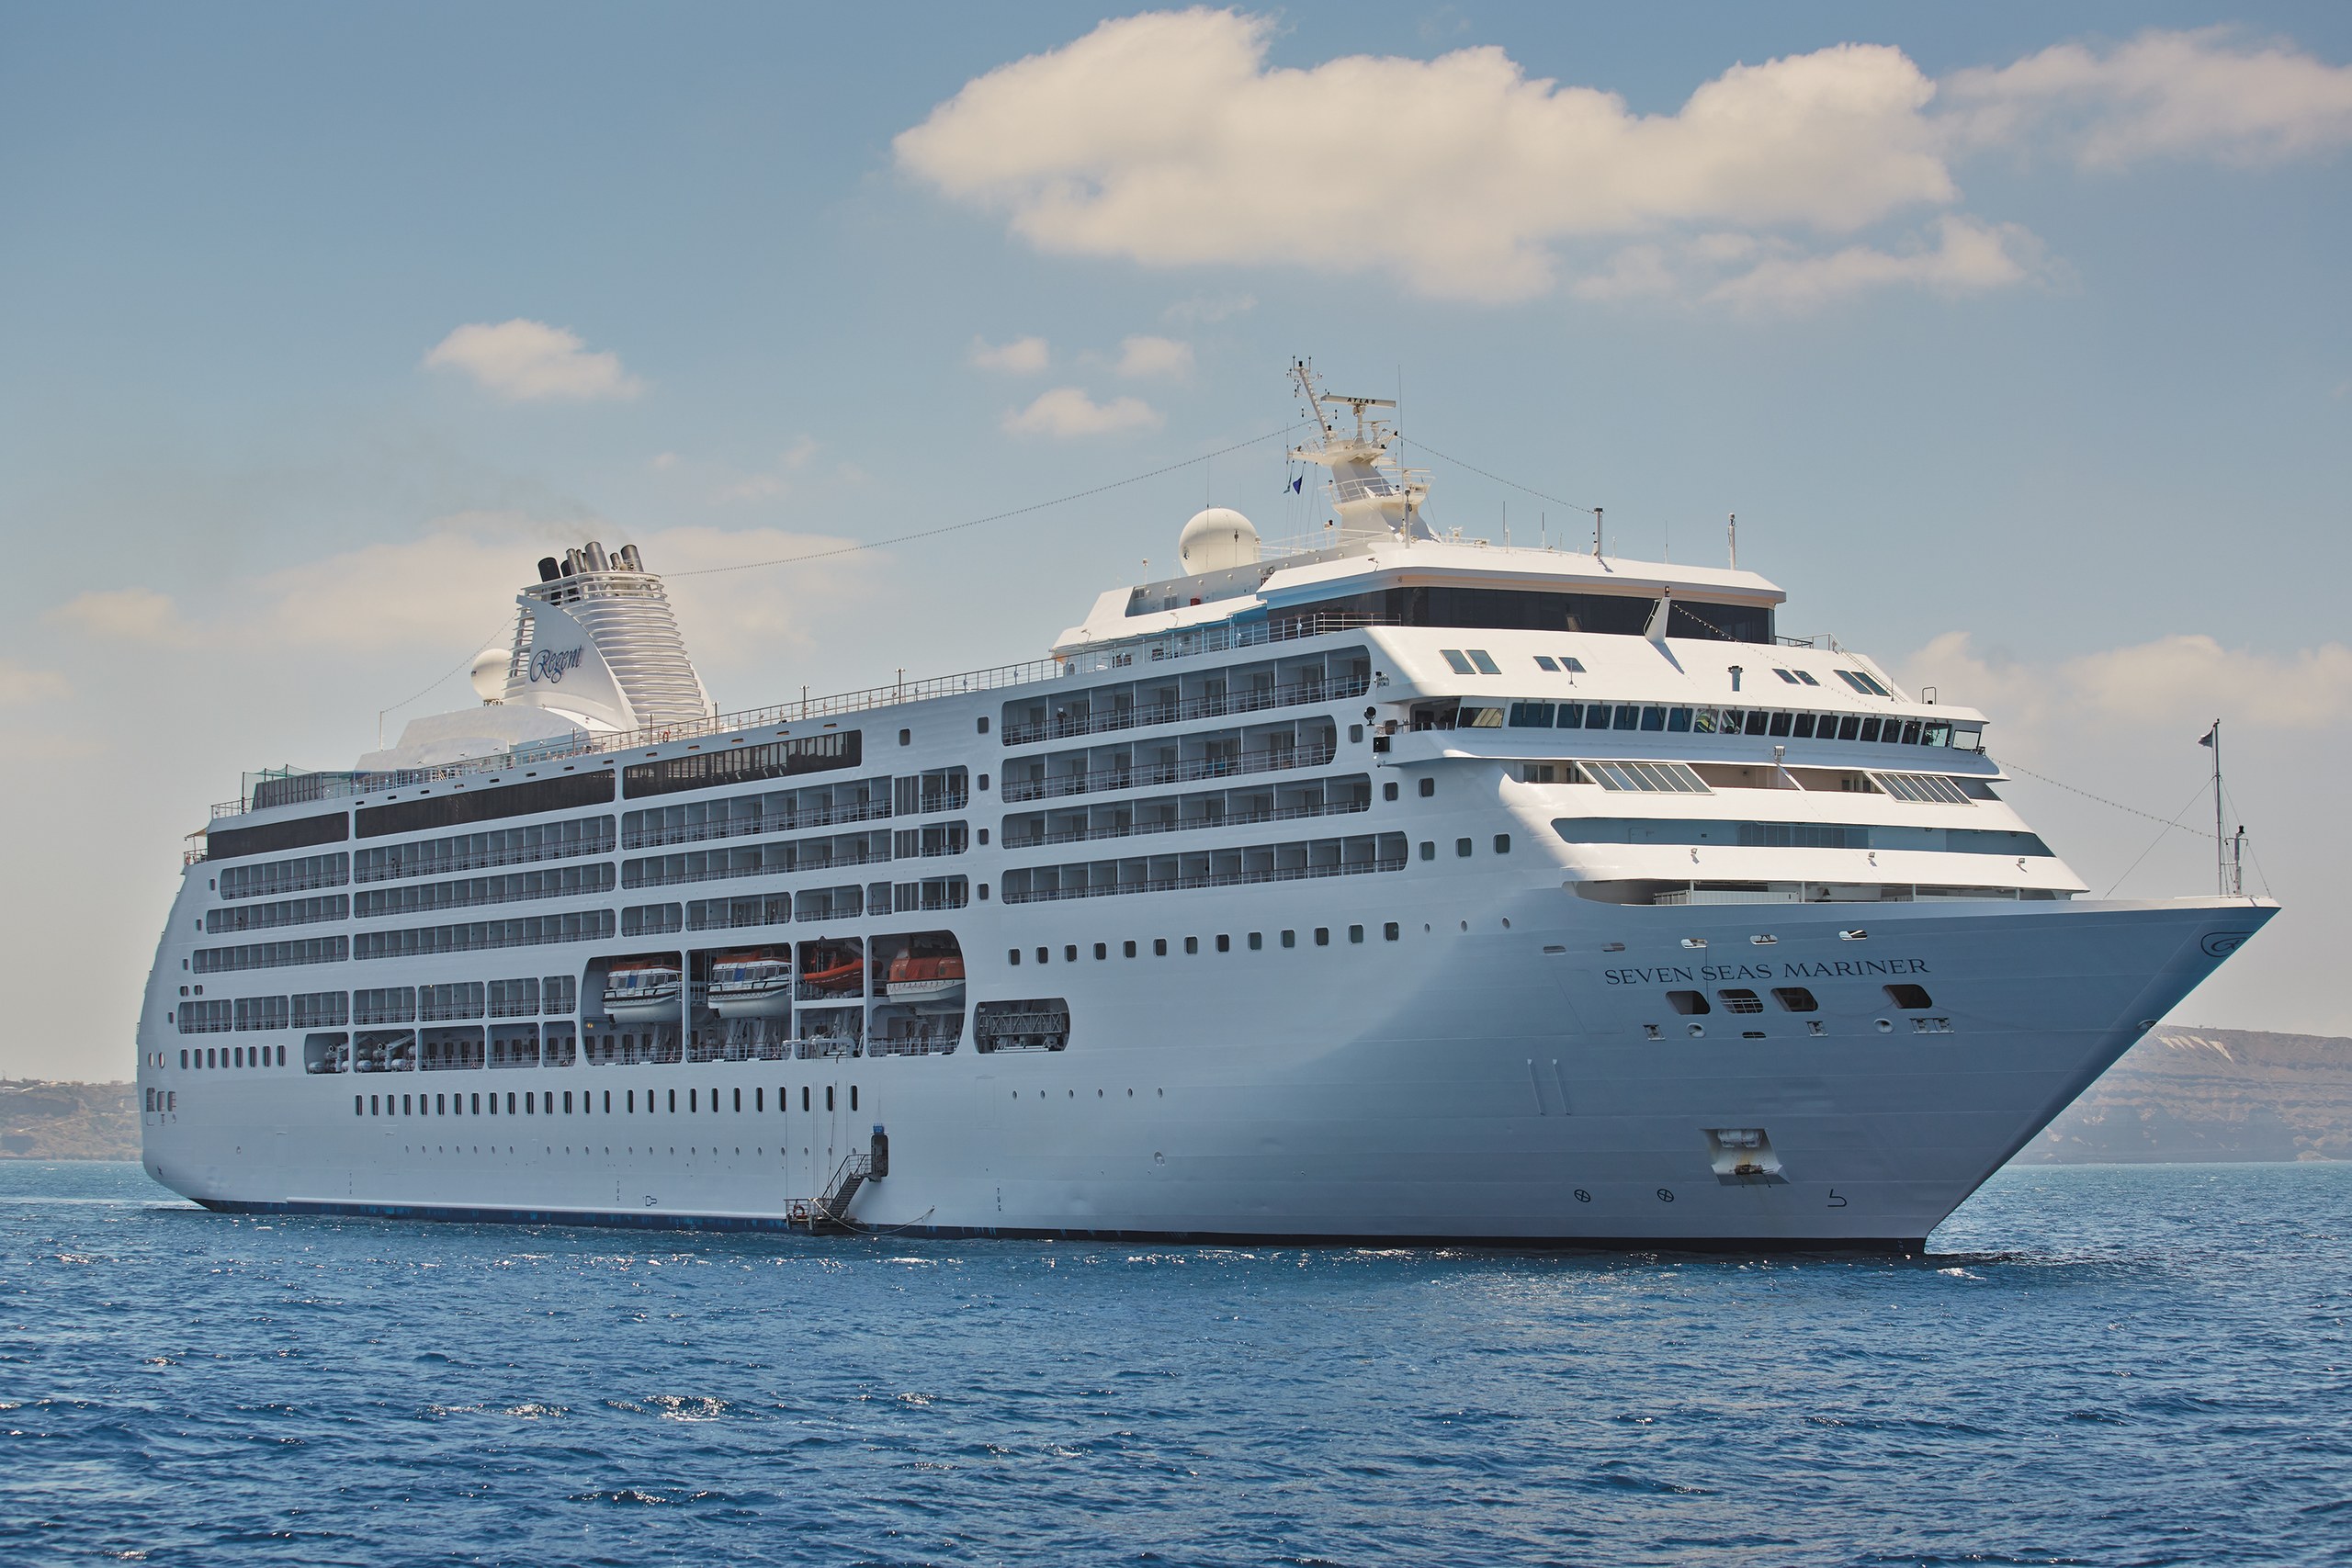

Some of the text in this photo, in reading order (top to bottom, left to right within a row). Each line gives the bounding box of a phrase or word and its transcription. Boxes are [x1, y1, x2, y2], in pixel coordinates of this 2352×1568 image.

[530, 644, 583, 683] Regent
[1604, 959, 1931, 985] SEVEN SEAS MARINER
